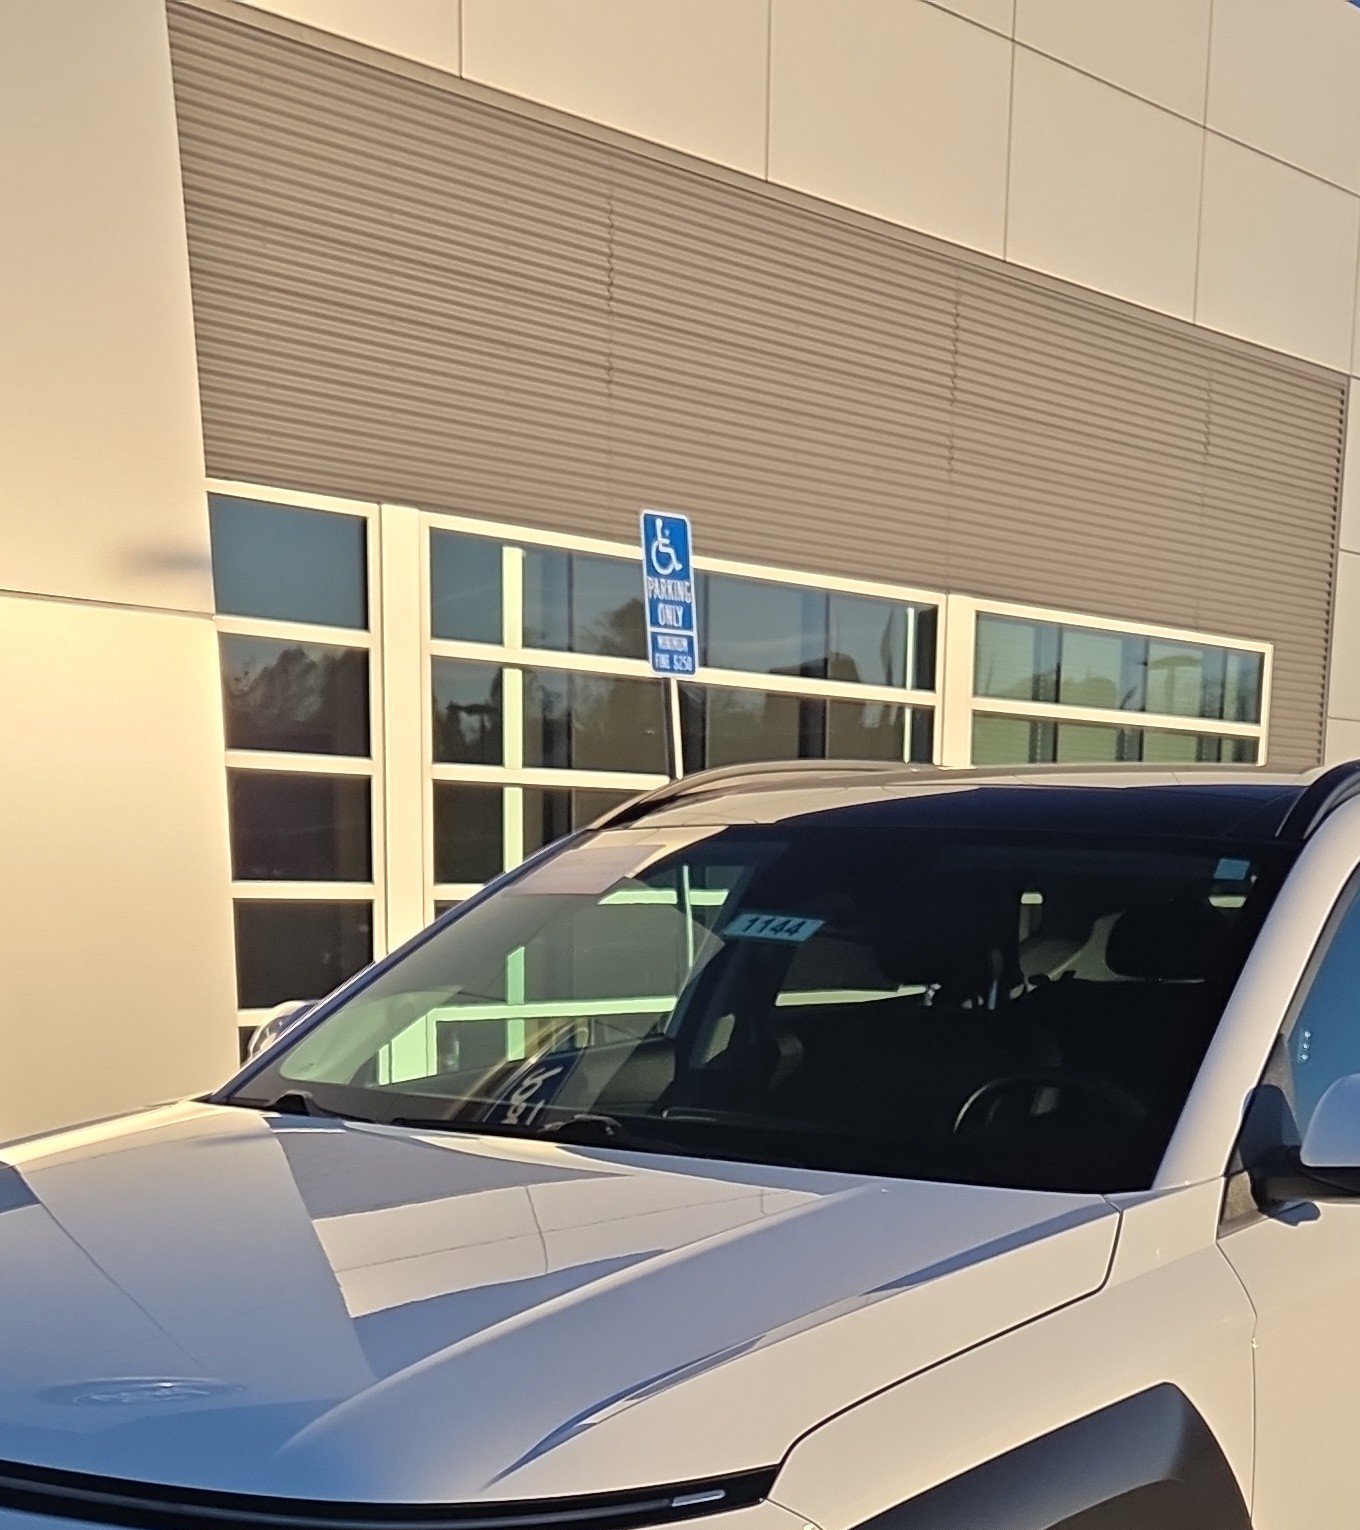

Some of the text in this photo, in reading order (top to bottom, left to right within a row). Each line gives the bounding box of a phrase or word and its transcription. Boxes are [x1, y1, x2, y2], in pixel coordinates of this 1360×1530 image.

[647, 576, 692, 604] PARKING
[658, 602, 684, 628] ONLY
[654, 652, 671, 670] FINE
[741, 917, 808, 936] 1144
